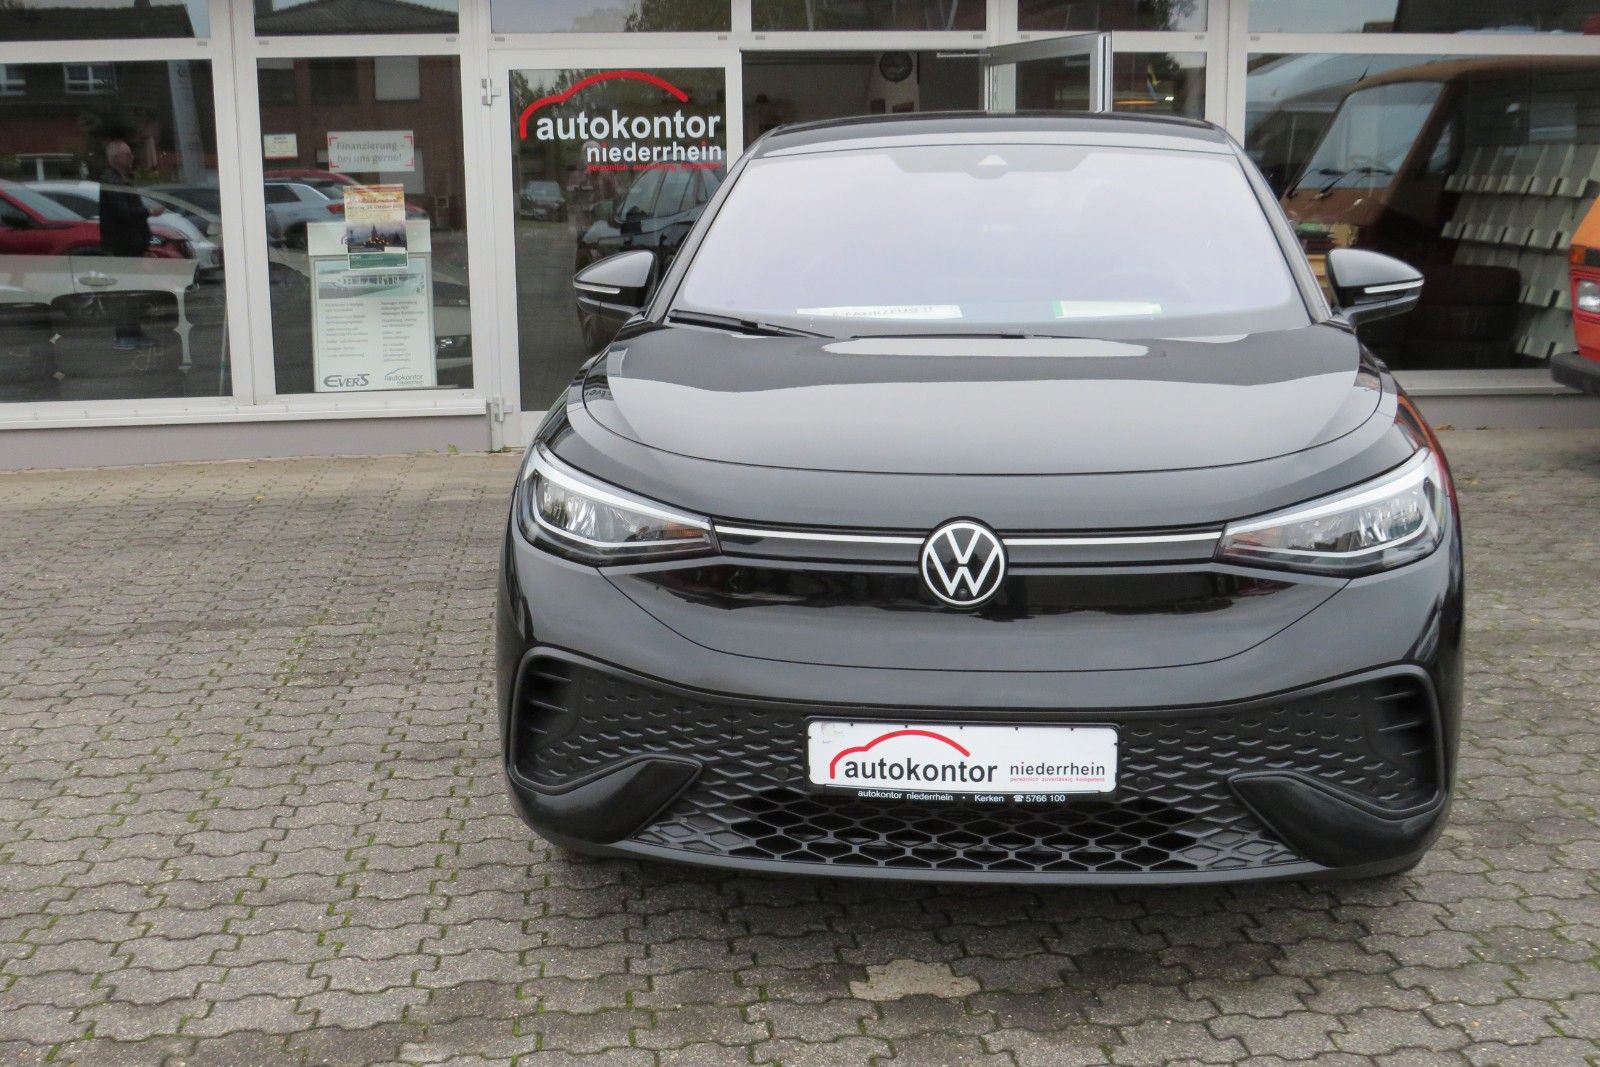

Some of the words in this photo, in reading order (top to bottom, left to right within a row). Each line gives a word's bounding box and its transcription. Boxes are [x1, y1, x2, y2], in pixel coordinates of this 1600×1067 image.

[536, 109, 721, 140] autokontor
[336, 140, 397, 153] Finanzierung
[586, 140, 722, 163] niederrhein
[844, 757, 998, 783] autokontor
[1010, 761, 1106, 776] niederrhein
[857, 790, 902, 799] autokontor
[906, 792, 954, 802] niederrhein
[974, 795, 1005, 803] Kerken
[1025, 795, 1047, 803] 5766
[1050, 795, 1066, 803] 100
